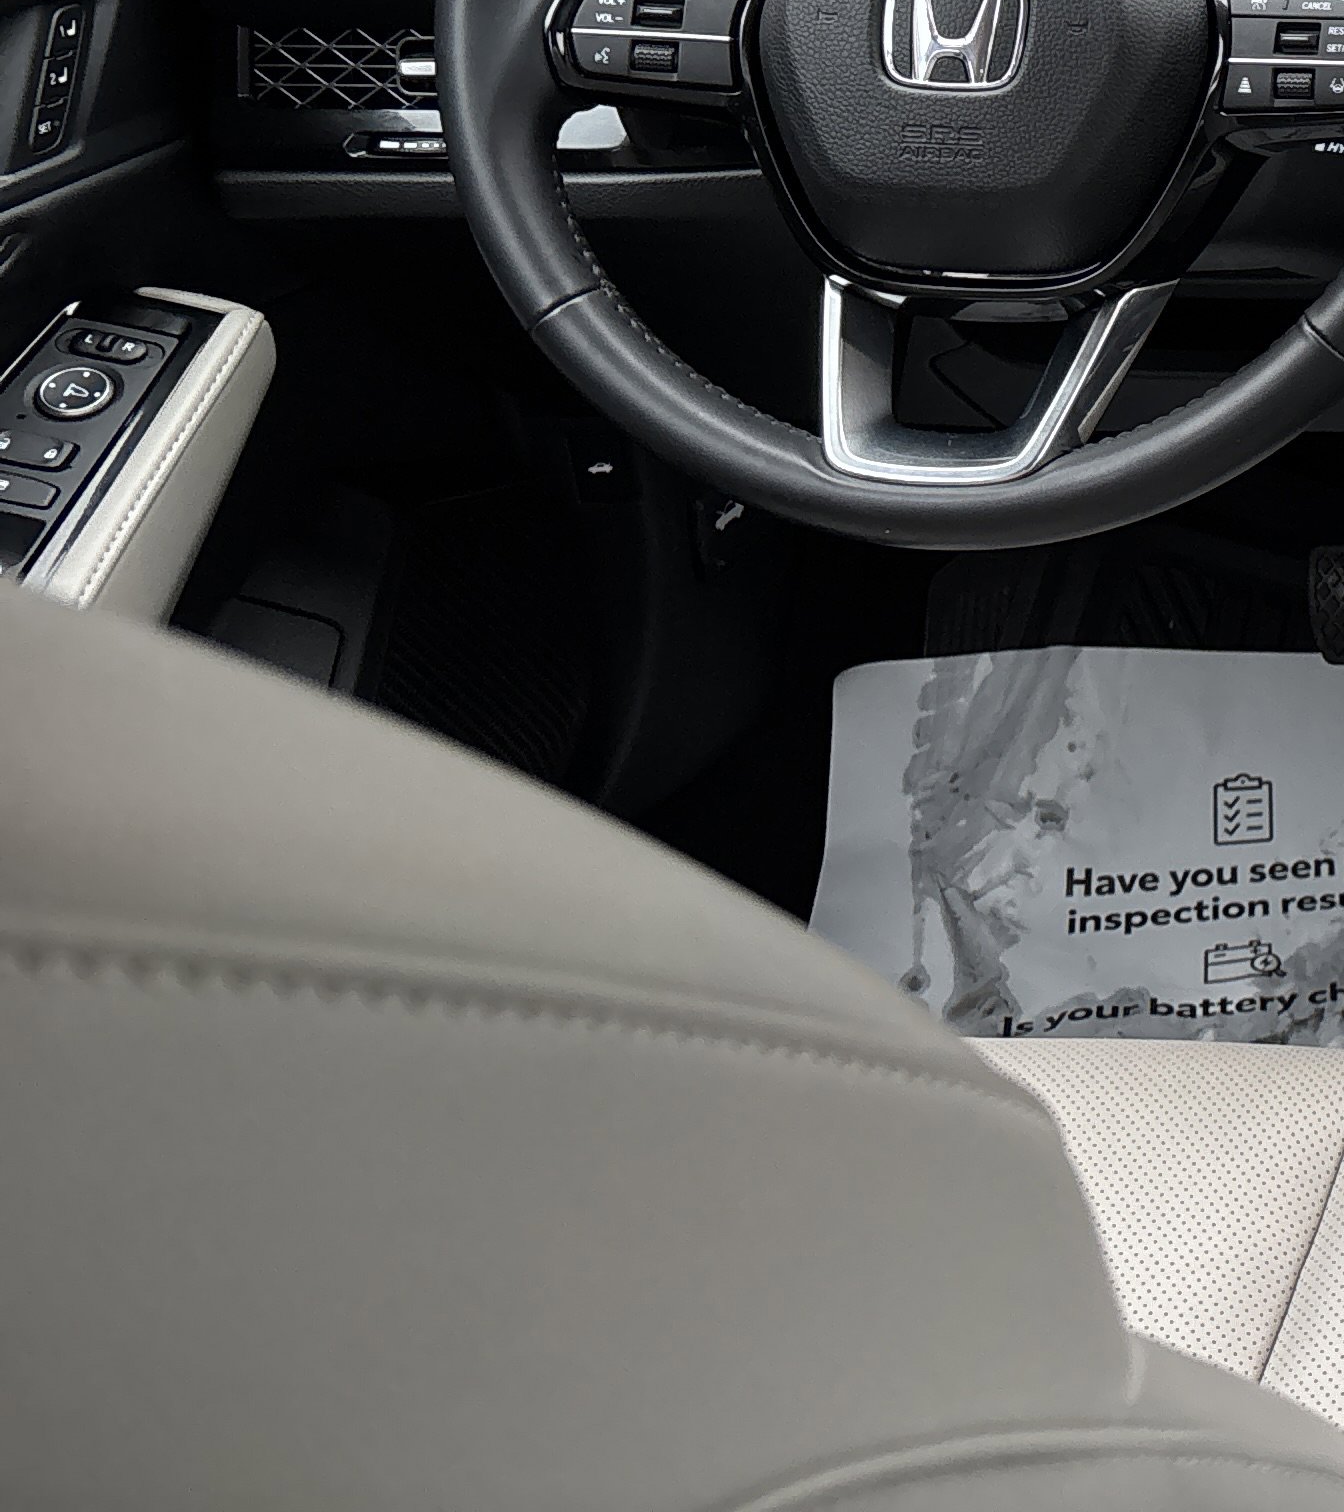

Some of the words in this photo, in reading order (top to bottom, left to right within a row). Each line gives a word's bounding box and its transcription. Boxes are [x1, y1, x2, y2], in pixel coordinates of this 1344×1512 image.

[1301, 1, 1332, 11] CANCEL
[901, 124, 984, 143] SRS
[900, 147, 984, 161] AIRBAG
[122, 341, 136, 352] R
[1064, 866, 1160, 898] Have
[1168, 865, 1239, 897] you
[1249, 854, 1336, 883] seen
[1066, 896, 1270, 936] inspection
[1001, 1015, 1035, 1038] Is
[1043, 1000, 1139, 1033] your
[1148, 988, 1299, 1021] battery
